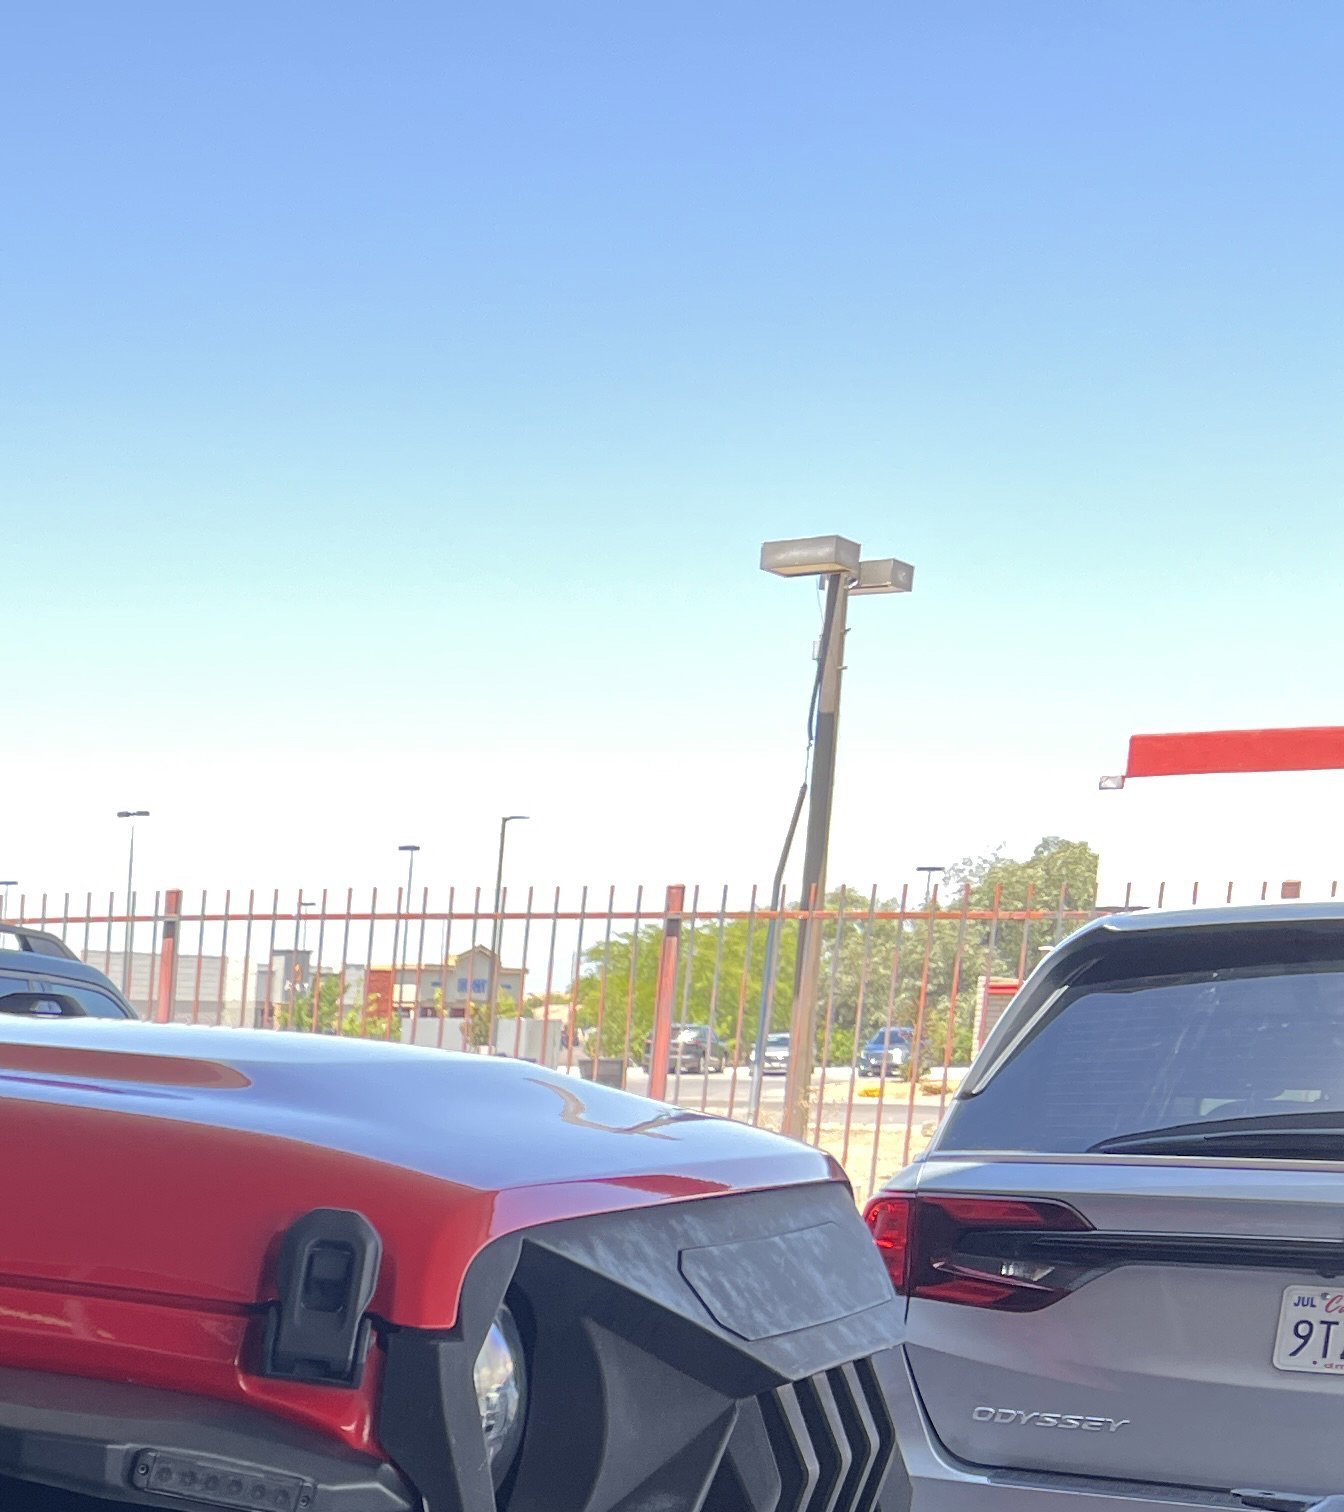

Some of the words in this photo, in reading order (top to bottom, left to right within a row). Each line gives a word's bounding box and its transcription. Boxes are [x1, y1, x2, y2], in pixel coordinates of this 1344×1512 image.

[1293, 1296, 1316, 1308] JUL
[1289, 1319, 1344, 1360] 9T
[972, 1406, 1131, 1432] ODYSSEY
